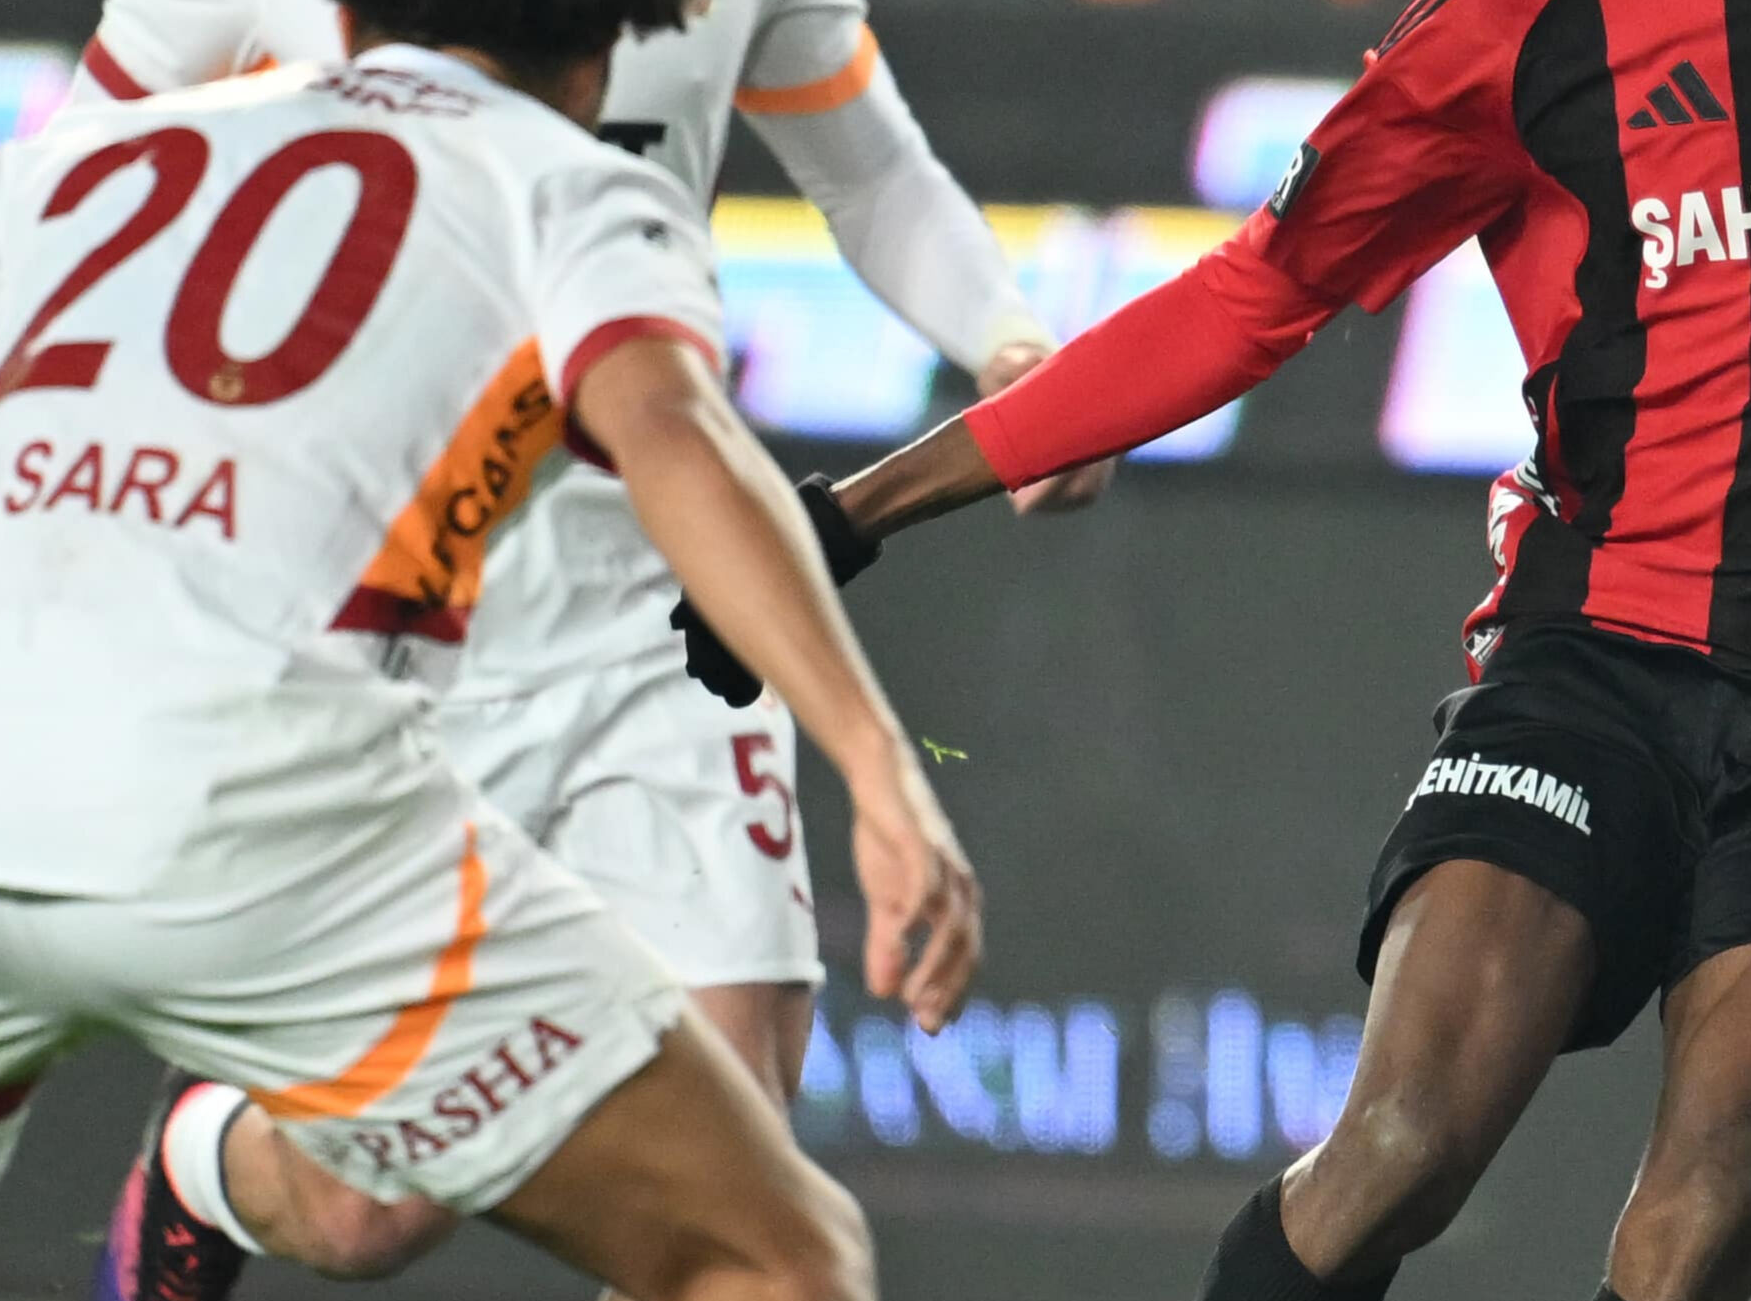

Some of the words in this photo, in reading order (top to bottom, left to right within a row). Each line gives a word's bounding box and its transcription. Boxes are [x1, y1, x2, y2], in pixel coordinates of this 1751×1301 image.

[5, 440, 239, 540] SARA
[1405, 751, 1591, 836] EHİTKAMİL
[353, 1016, 587, 1172] PASHA
